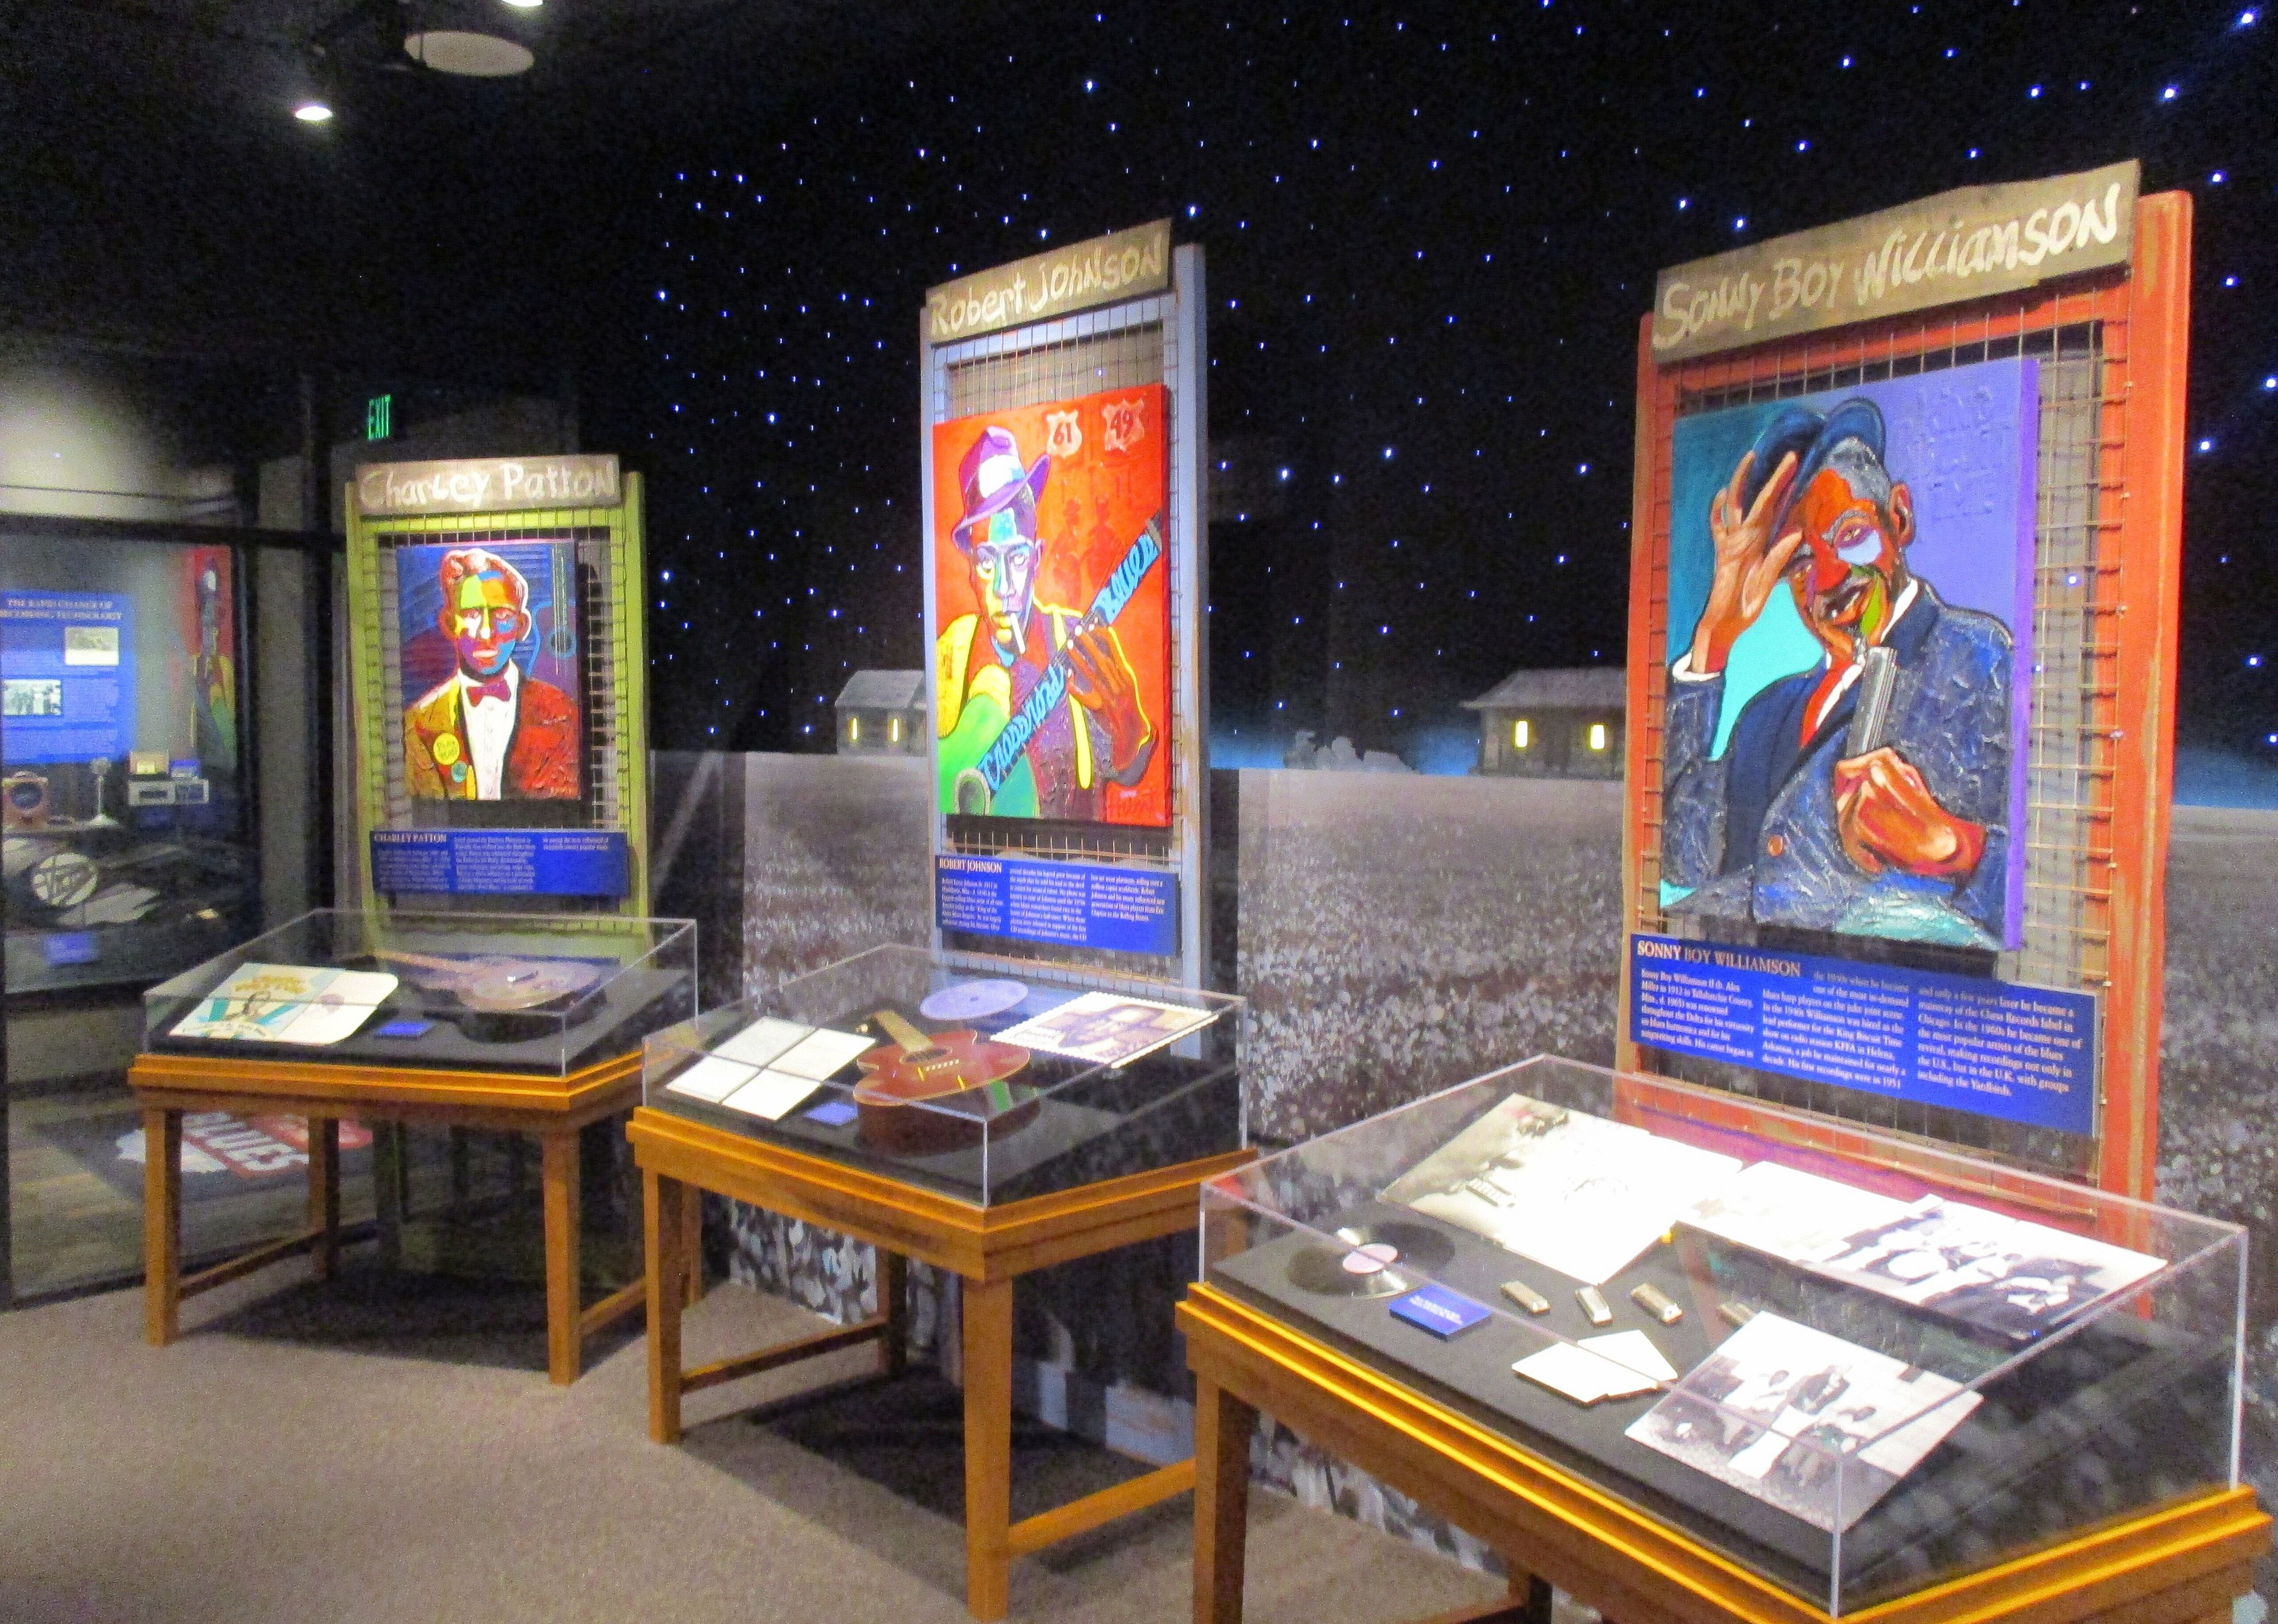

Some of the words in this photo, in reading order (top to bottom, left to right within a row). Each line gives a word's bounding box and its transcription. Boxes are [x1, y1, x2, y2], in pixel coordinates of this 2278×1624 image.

[367, 394, 391, 440] EXIT
[1053, 423, 1073, 443] 61
[1111, 407, 1134, 439] 49
[939, 858, 966, 872] ROBERT
[967, 860, 1002, 874] JOHNSON
[1637, 940, 1681, 961] SONNY
[1685, 947, 1710, 964] BOY
[1713, 951, 1801, 977] WILLIAMSON
